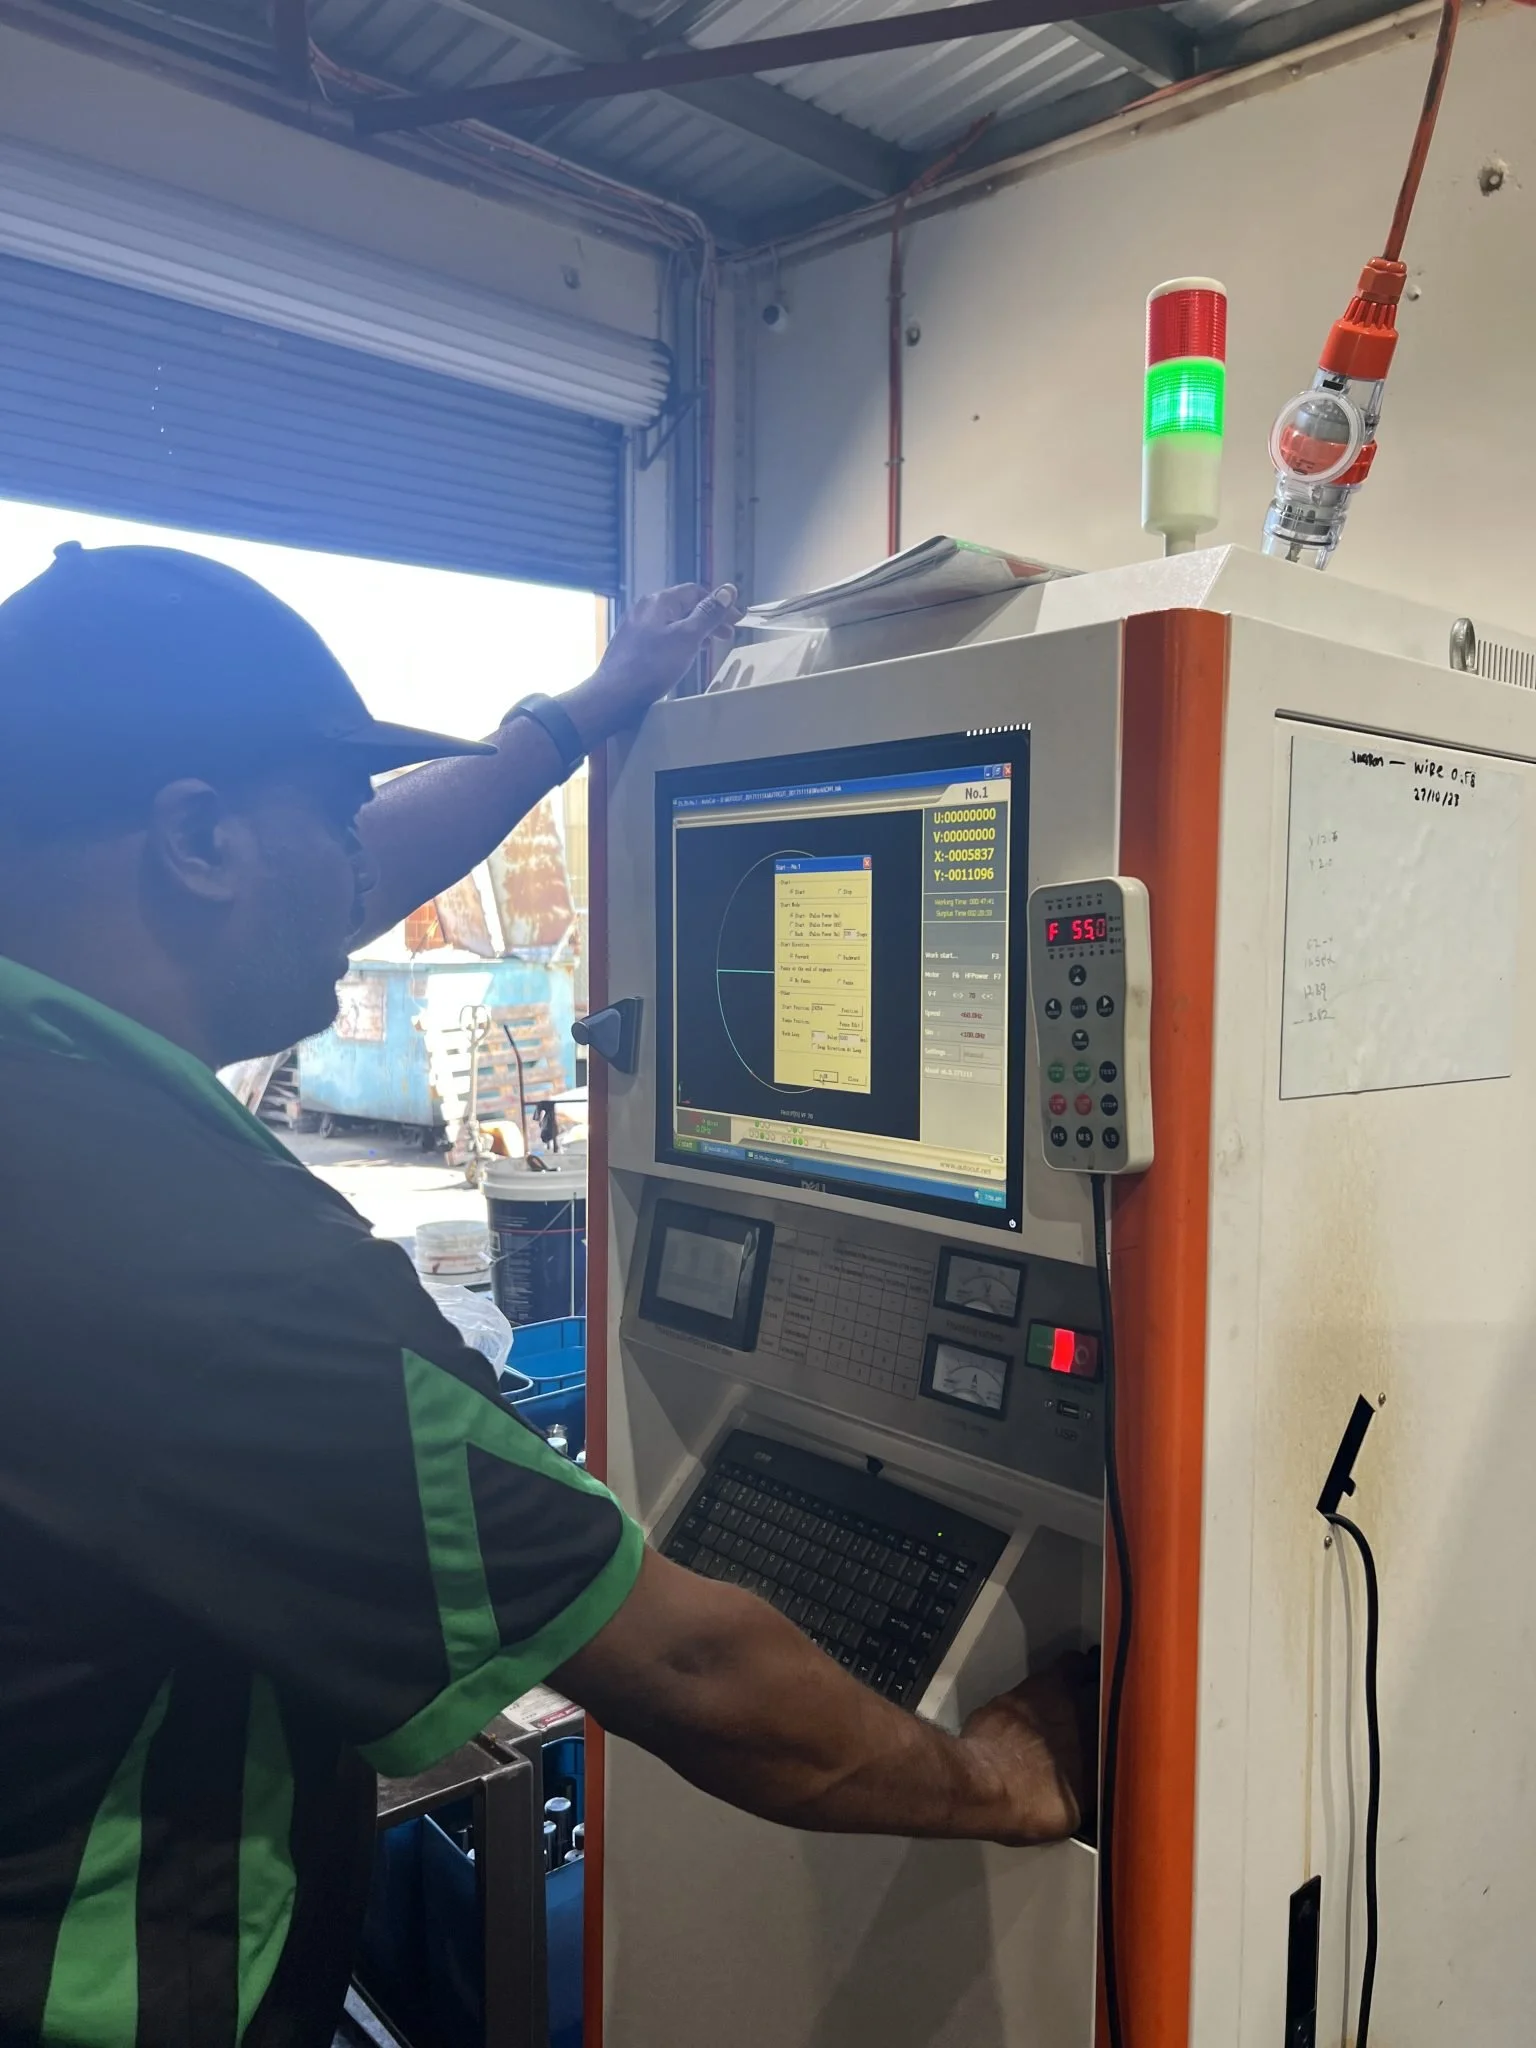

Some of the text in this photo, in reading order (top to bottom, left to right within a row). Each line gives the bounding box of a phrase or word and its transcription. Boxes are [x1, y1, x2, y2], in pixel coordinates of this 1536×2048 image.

[965, 787, 988, 800] No.1
[933, 808, 996, 824] U:00000000
[933, 828, 996, 843] V:00000000
[934, 848, 995, 862] X:-0005837
[934, 868, 994, 881] Y:-0011096
[991, 952, 1000, 960] F3
[1078, 1132, 1091, 1141] MS
